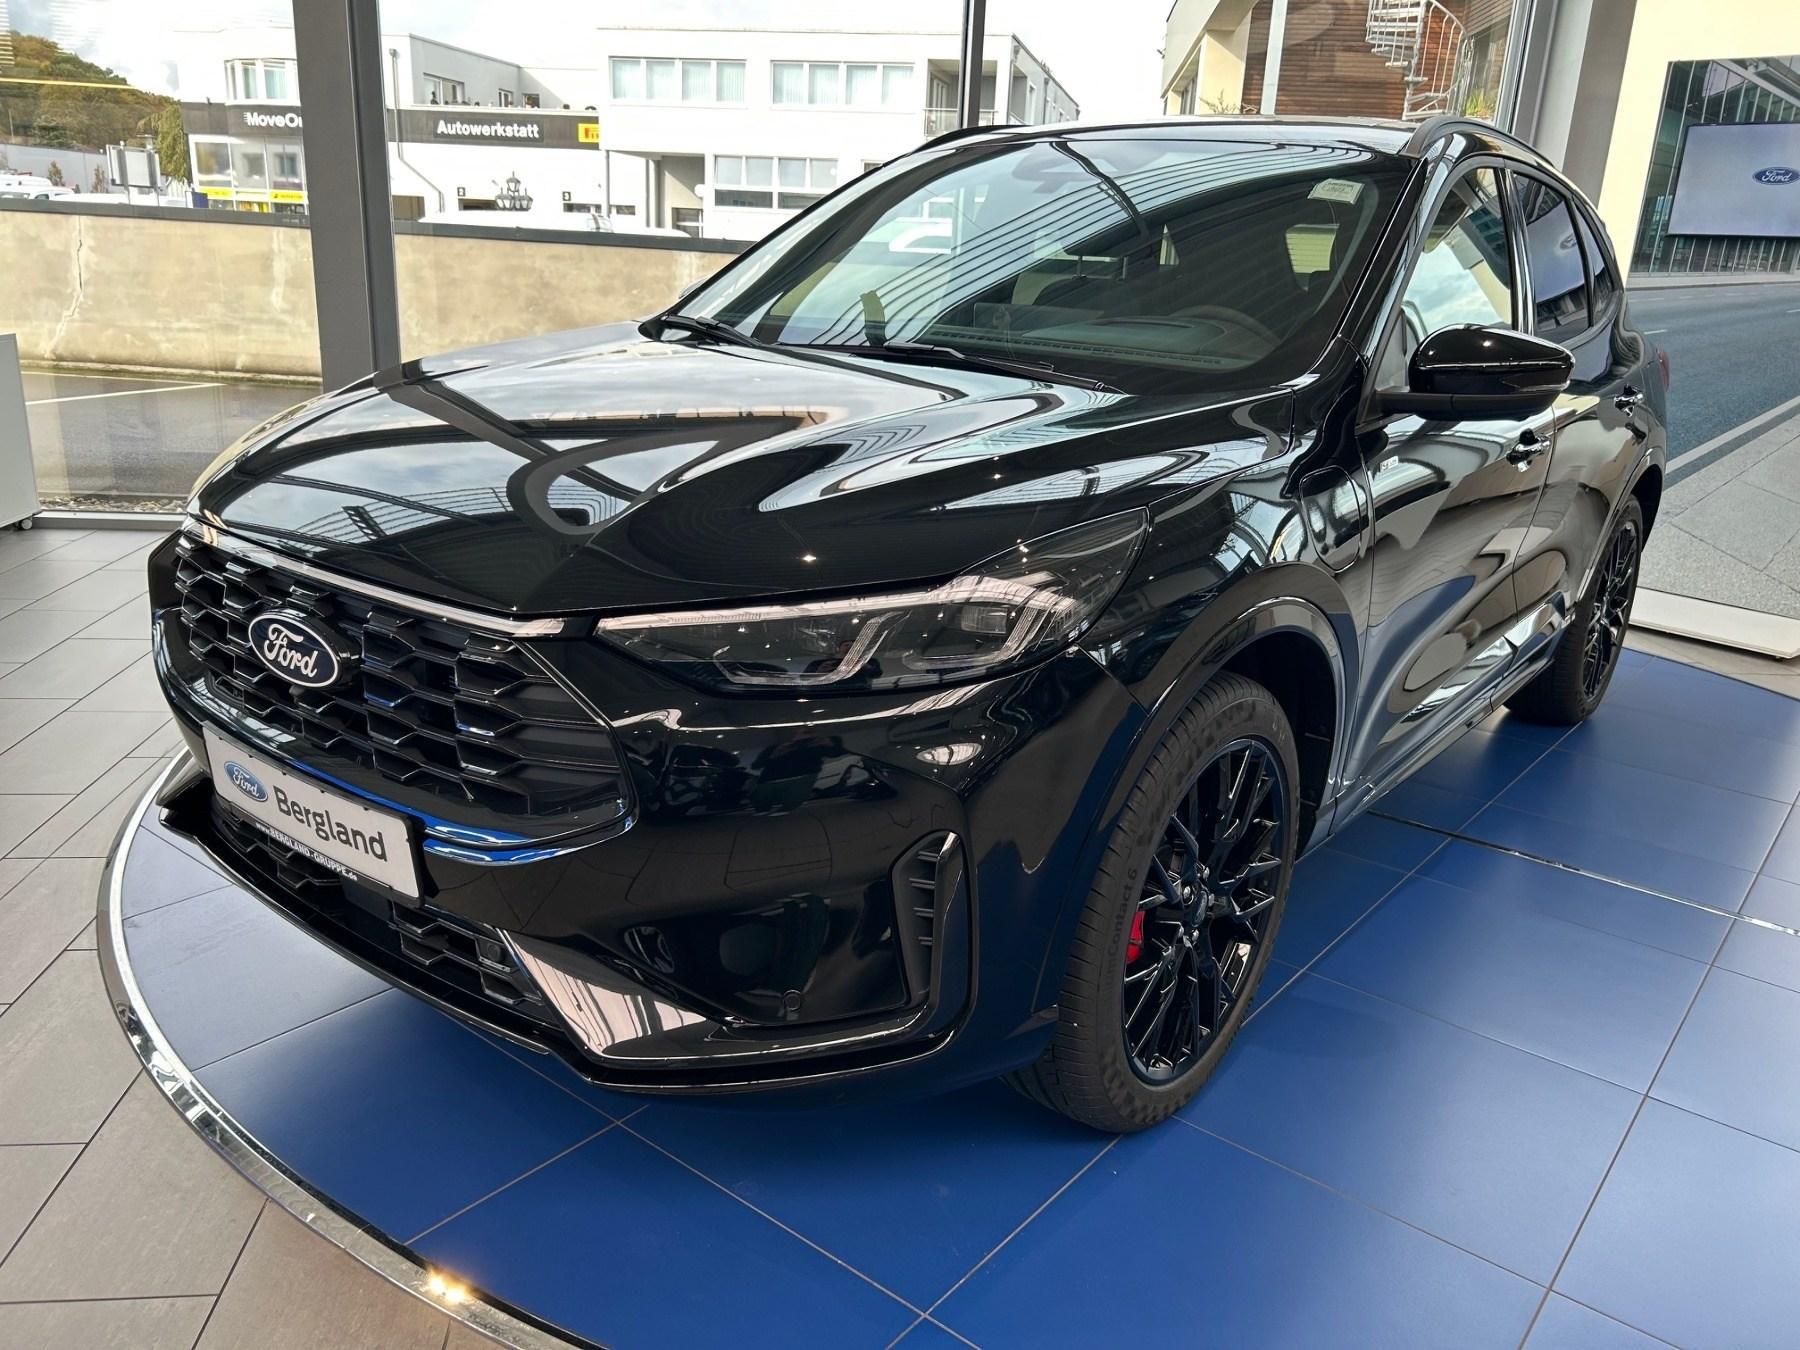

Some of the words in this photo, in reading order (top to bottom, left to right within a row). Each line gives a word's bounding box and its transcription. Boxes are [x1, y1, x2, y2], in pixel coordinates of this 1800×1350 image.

[437, 120, 539, 139] Autowerkstatt
[1761, 169, 1793, 182] Ford
[264, 623, 318, 678] Ford
[232, 766, 260, 798] Ford
[273, 785, 387, 862] Bergland
[255, 822, 358, 881] www.BERGLAND-GRUPPE.de
